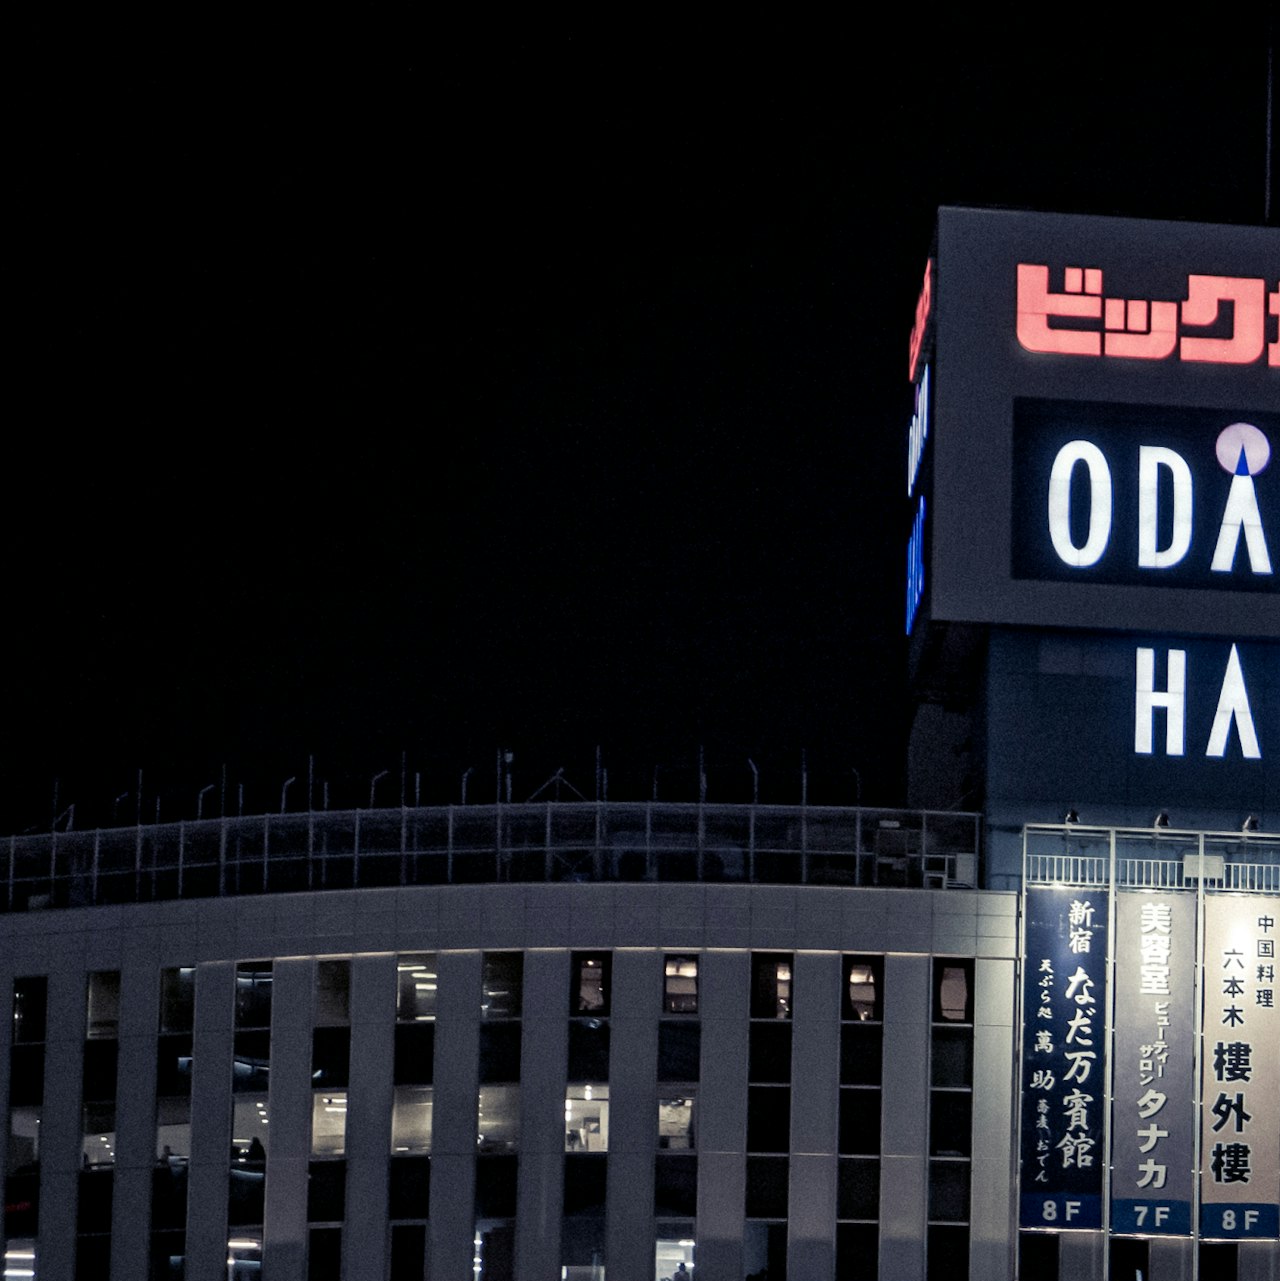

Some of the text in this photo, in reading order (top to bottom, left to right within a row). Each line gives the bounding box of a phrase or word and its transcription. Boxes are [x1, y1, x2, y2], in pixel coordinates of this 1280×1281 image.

[1139, 902, 1171, 995] 美容室
[1222, 948, 1245, 1028] 六本木
[1255, 915, 1275, 1008] 中国料理
[1055, 900, 1097, 1169] 新宿 なだ万賓館
[1139, 1044, 1154, 1086] サロン
[1153, 1001, 1171, 1078] ビューティー
[1136, 1088, 1169, 1188] タナカ
